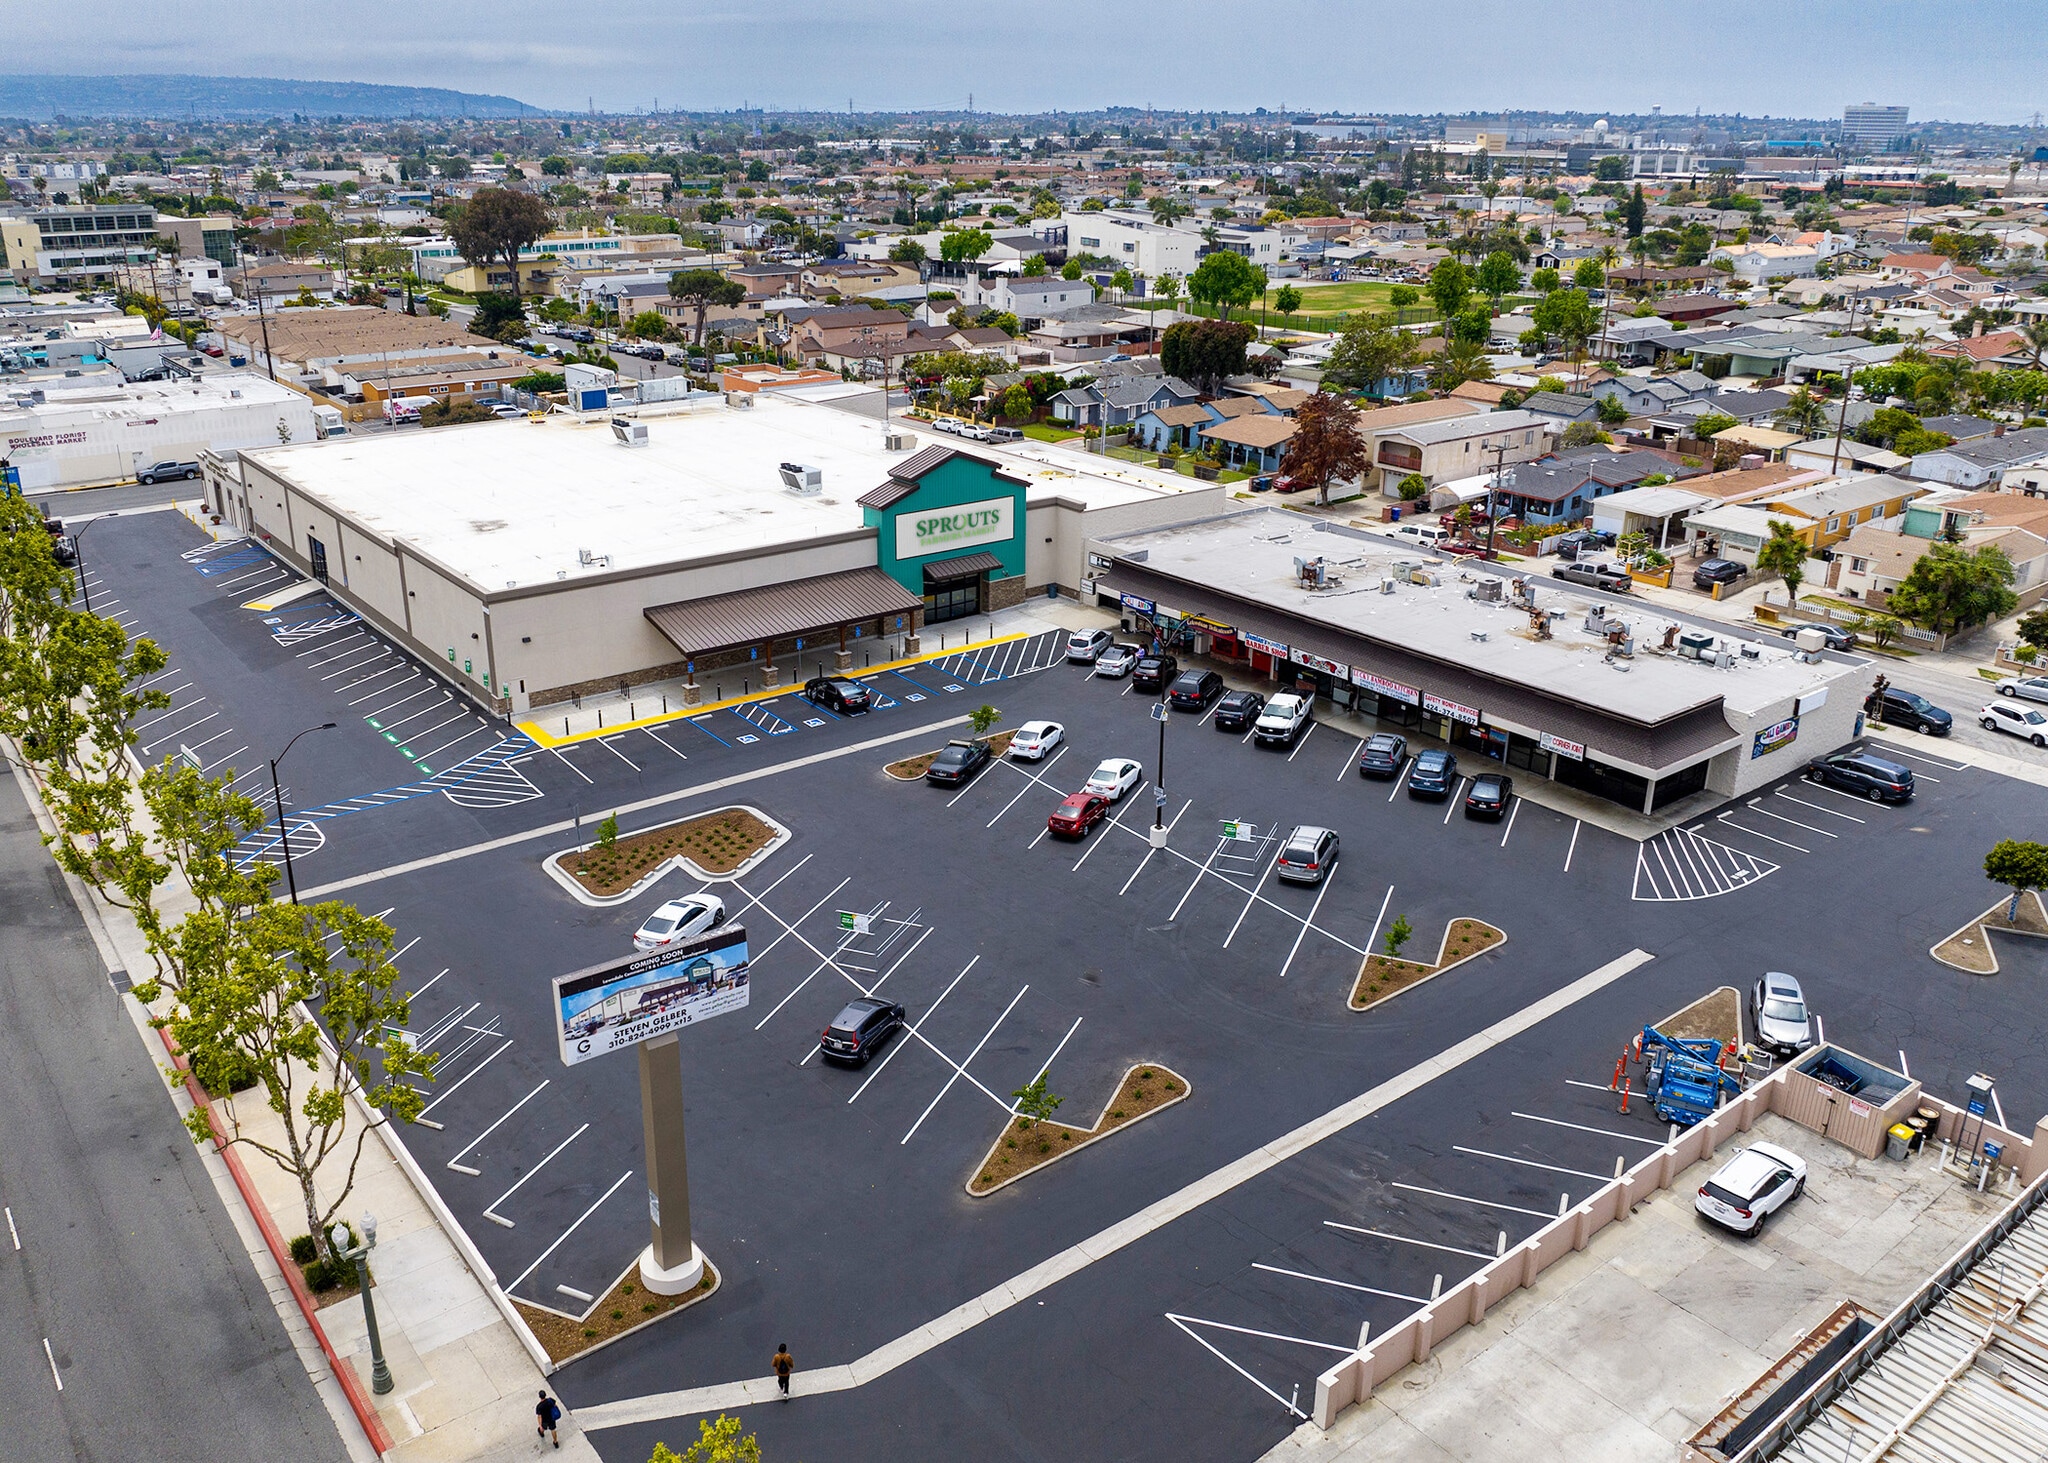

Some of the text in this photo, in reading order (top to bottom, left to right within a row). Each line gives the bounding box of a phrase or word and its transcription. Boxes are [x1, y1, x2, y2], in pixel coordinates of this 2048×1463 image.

[8, 432, 86, 444] BOULEVARD FLORIST
[9, 437, 87, 449] WHOLESALE MARKET
[916, 509, 1000, 537] SPROUTS
[1246, 640, 1269, 652] BARBER
[1271, 648, 1287, 658] SHOP
[1425, 694, 1480, 717] SAFETY MONEY SERVICES
[1552, 737, 1571, 750] CORNER
[629, 949, 684, 971] COMING SOON
[614, 1009, 687, 1039] STEVEN GELBER
[608, 1022, 671, 1050] 310-824-4999
[577, 1039, 591, 1054] G
